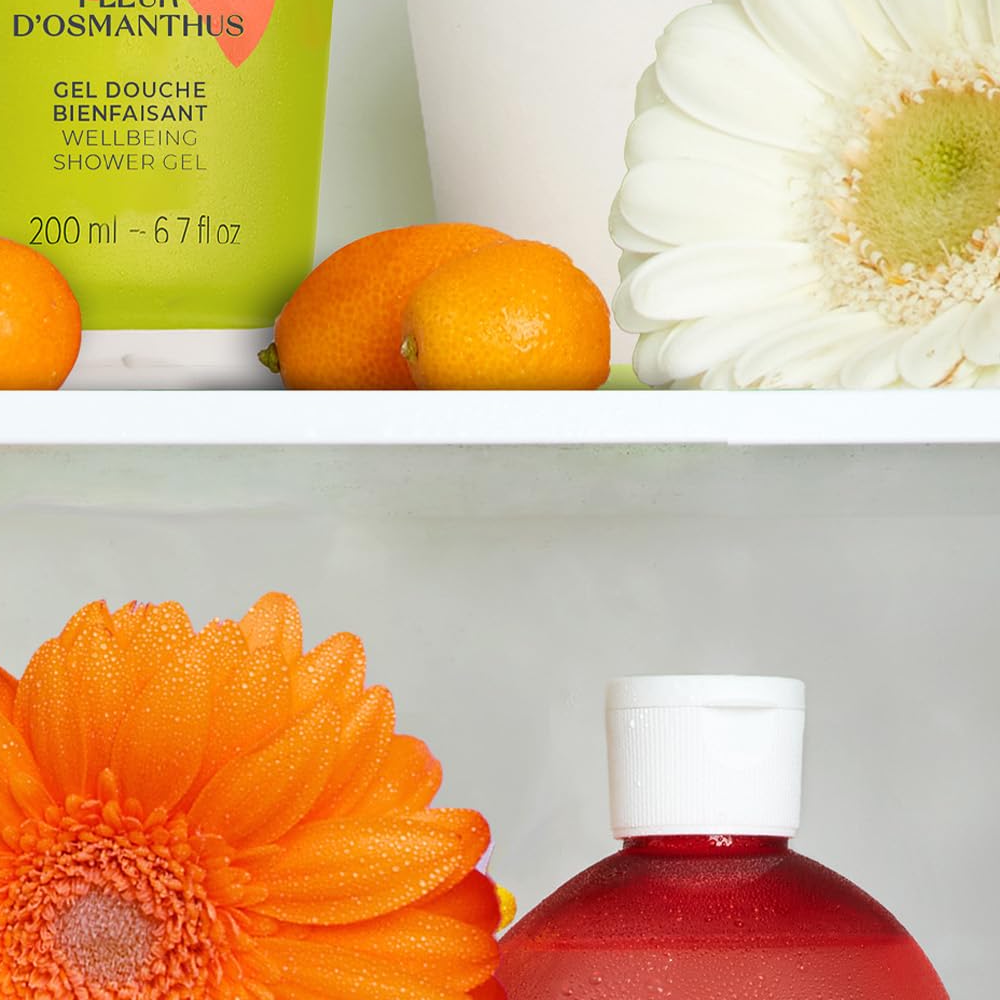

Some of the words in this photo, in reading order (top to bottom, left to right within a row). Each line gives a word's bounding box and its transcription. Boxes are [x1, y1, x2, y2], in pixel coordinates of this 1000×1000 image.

[12, 14, 245, 37] D'OSMANTHUS
[53, 81, 97, 99] GEL
[105, 81, 206, 99] DOUCHE
[53, 105, 208, 122] BIENFAISANT
[61, 130, 198, 147] WELLBEING
[53, 154, 155, 171] SHOWER
[162, 154, 207, 171] GEL
[29, 215, 81, 245] 200
[88, 215, 117, 245] ml
